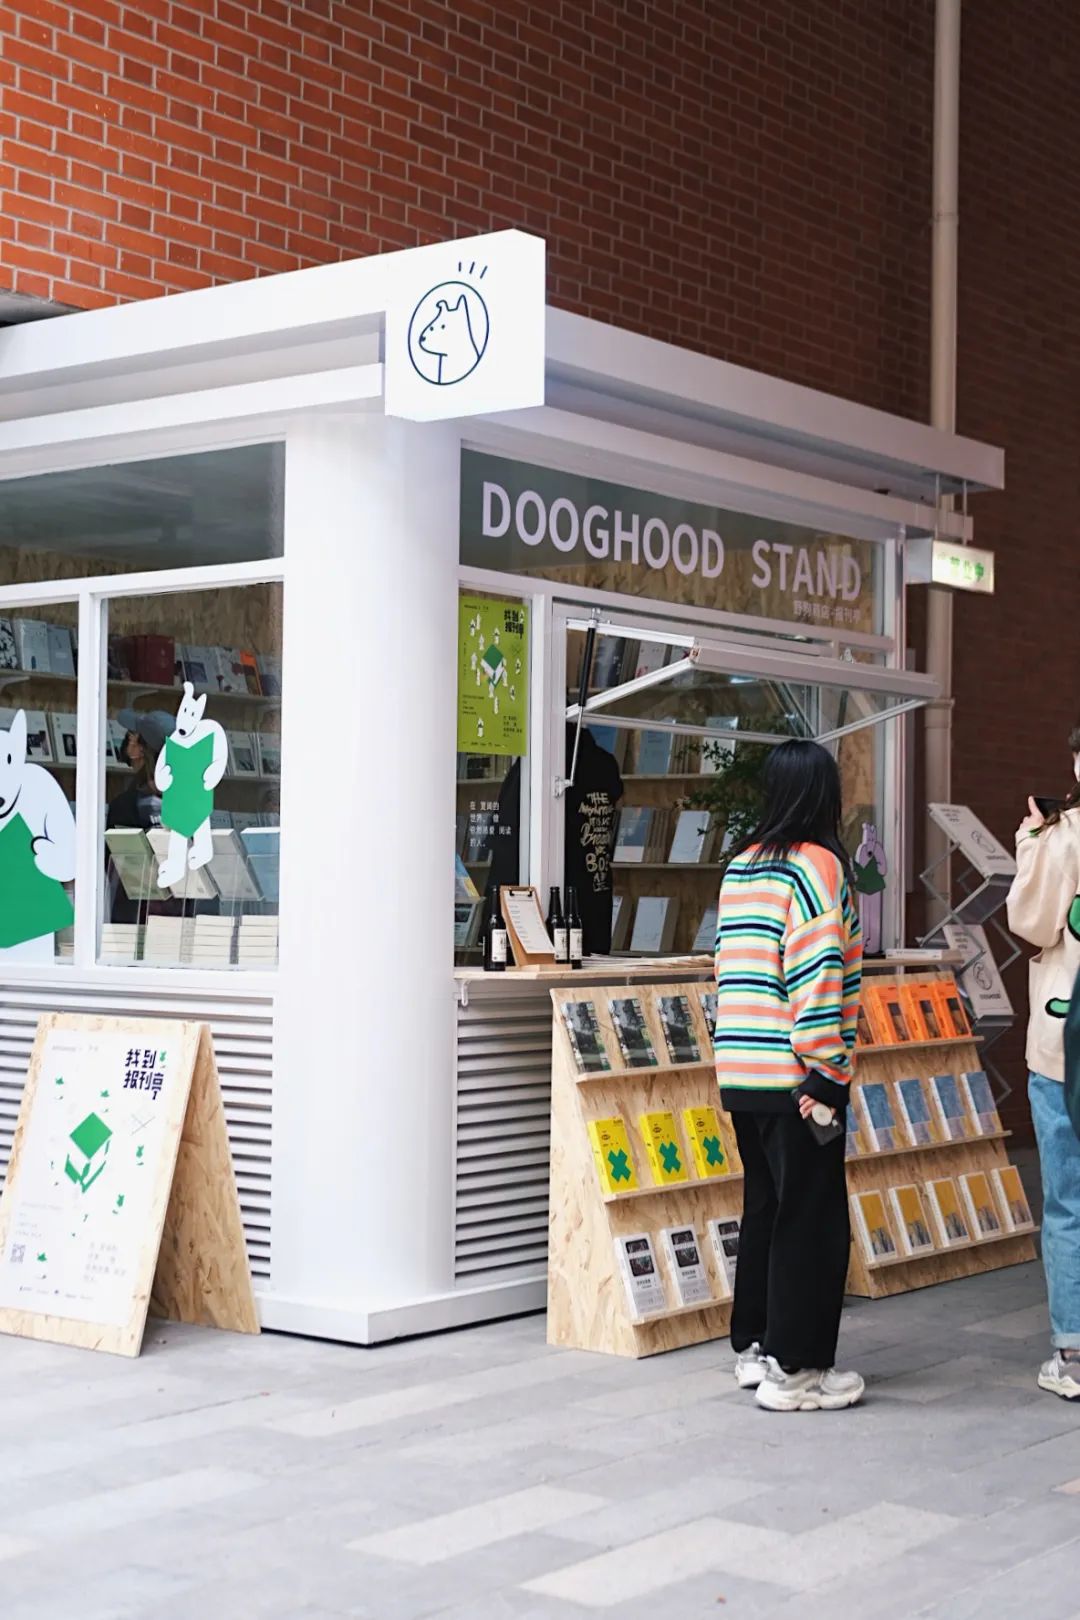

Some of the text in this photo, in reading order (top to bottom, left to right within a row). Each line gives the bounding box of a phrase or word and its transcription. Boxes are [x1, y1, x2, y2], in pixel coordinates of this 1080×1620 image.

[481, 480, 862, 601] DOOGHOOD STAND
[124, 1048, 157, 1069] 找到
[123, 1069, 164, 1101] 报刊亭
